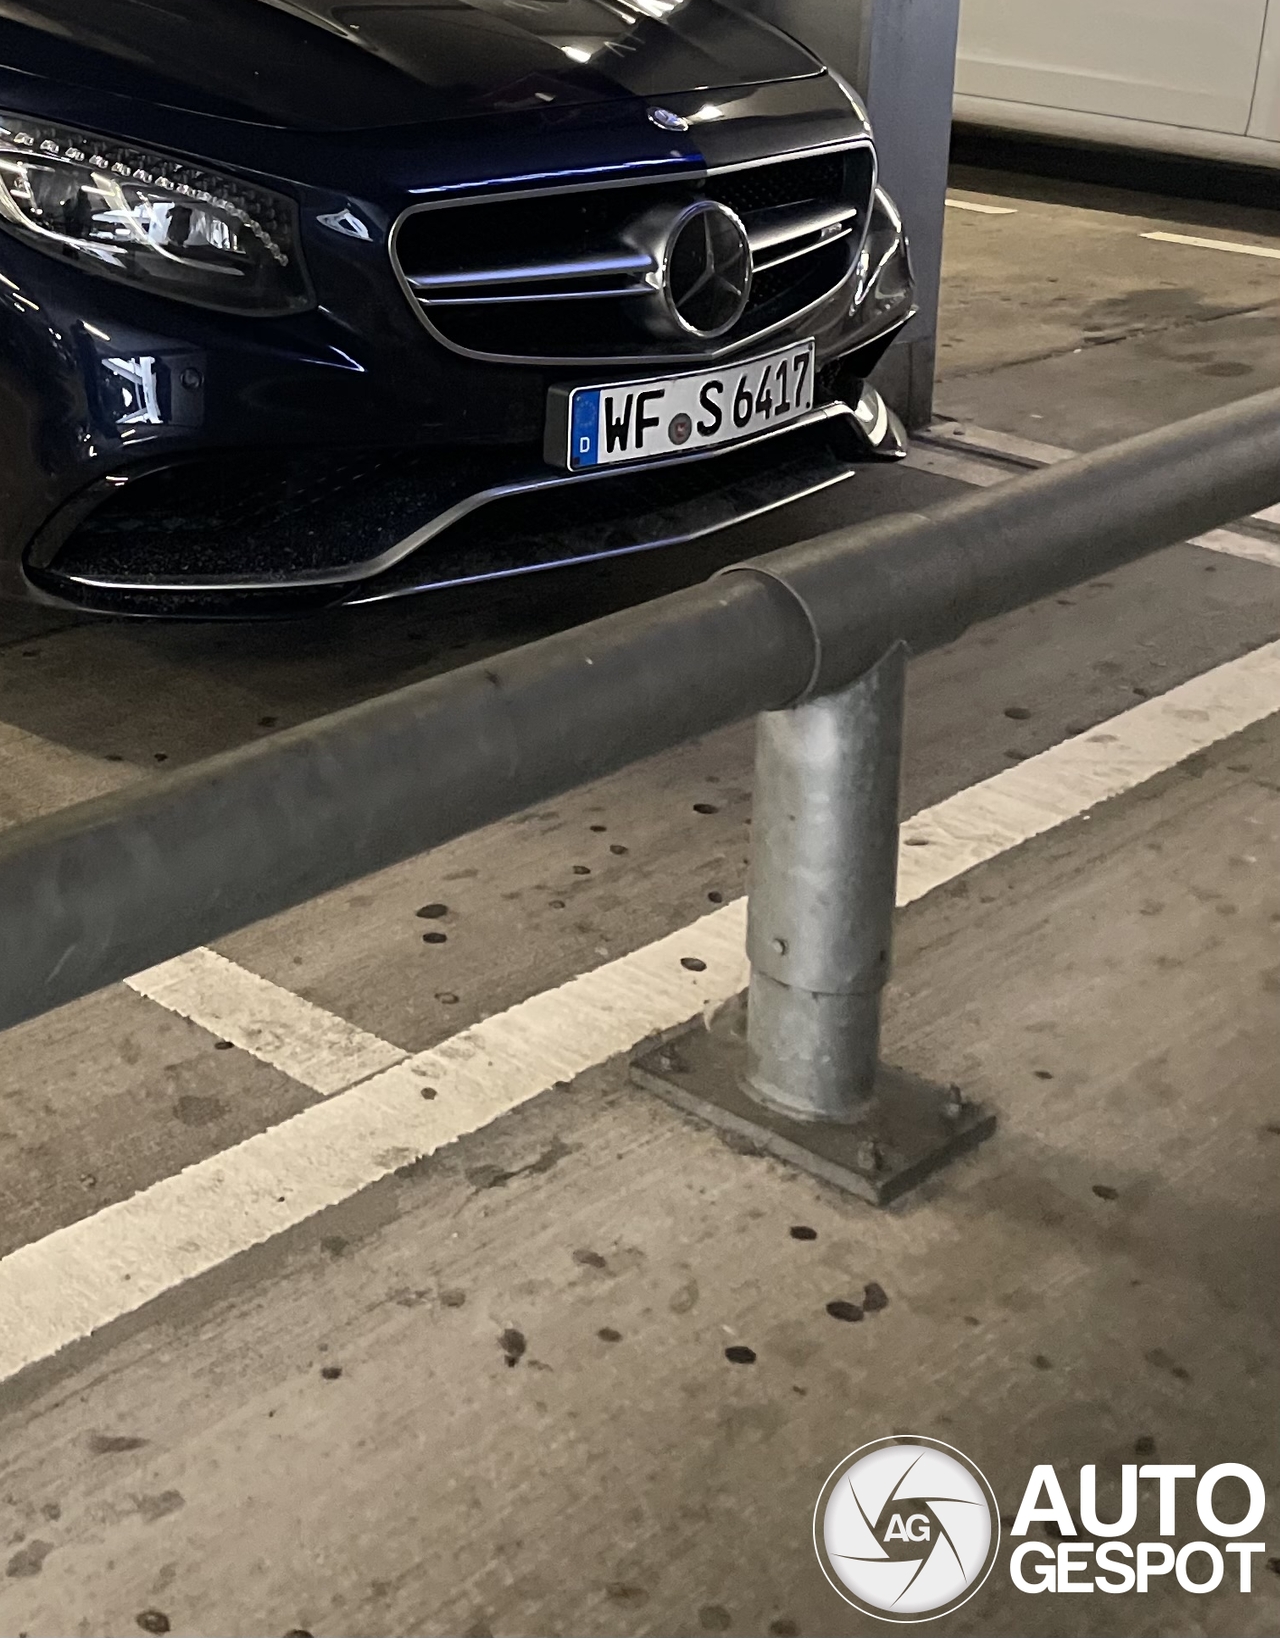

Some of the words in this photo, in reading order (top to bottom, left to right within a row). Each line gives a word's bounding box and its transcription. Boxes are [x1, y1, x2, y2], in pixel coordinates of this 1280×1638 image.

[604, 388, 665, 454] WF
[696, 380, 724, 437] S
[733, 352, 810, 428] 6417
[579, 436, 590, 453] D
